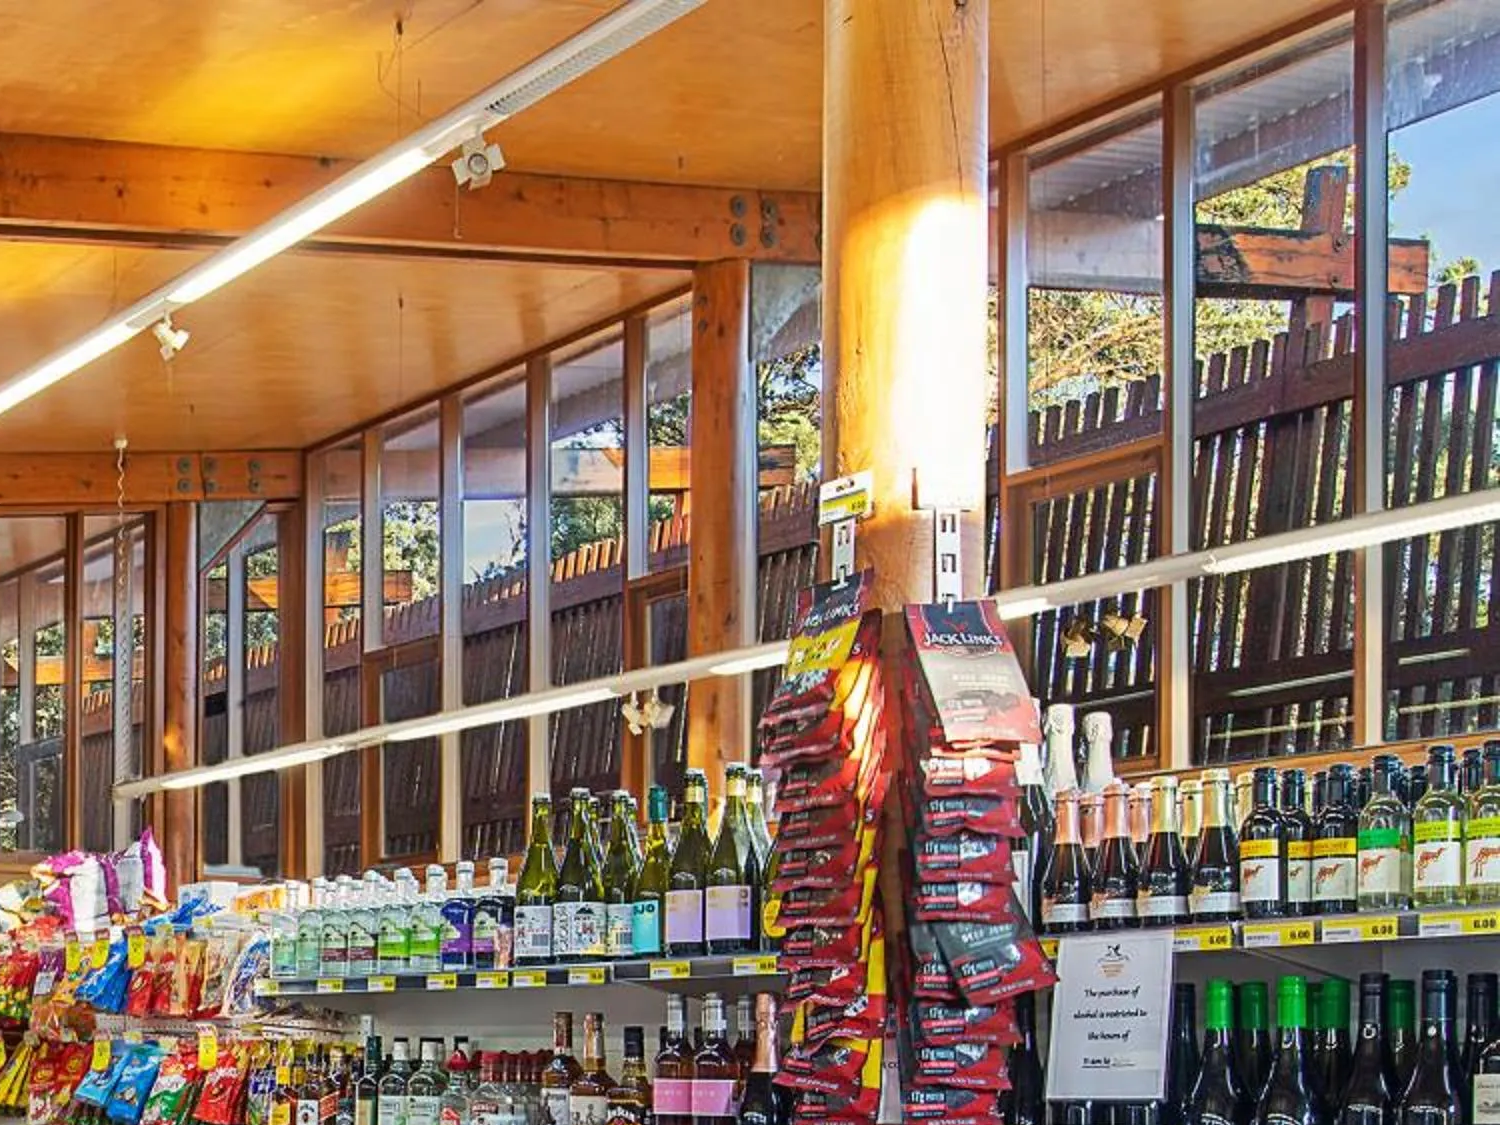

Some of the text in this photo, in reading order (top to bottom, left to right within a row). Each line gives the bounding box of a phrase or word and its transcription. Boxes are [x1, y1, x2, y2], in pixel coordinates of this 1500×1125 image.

[1084, 988, 1097, 998] The
[1129, 985, 1141, 999] of
[1121, 1030, 1131, 1042] of
